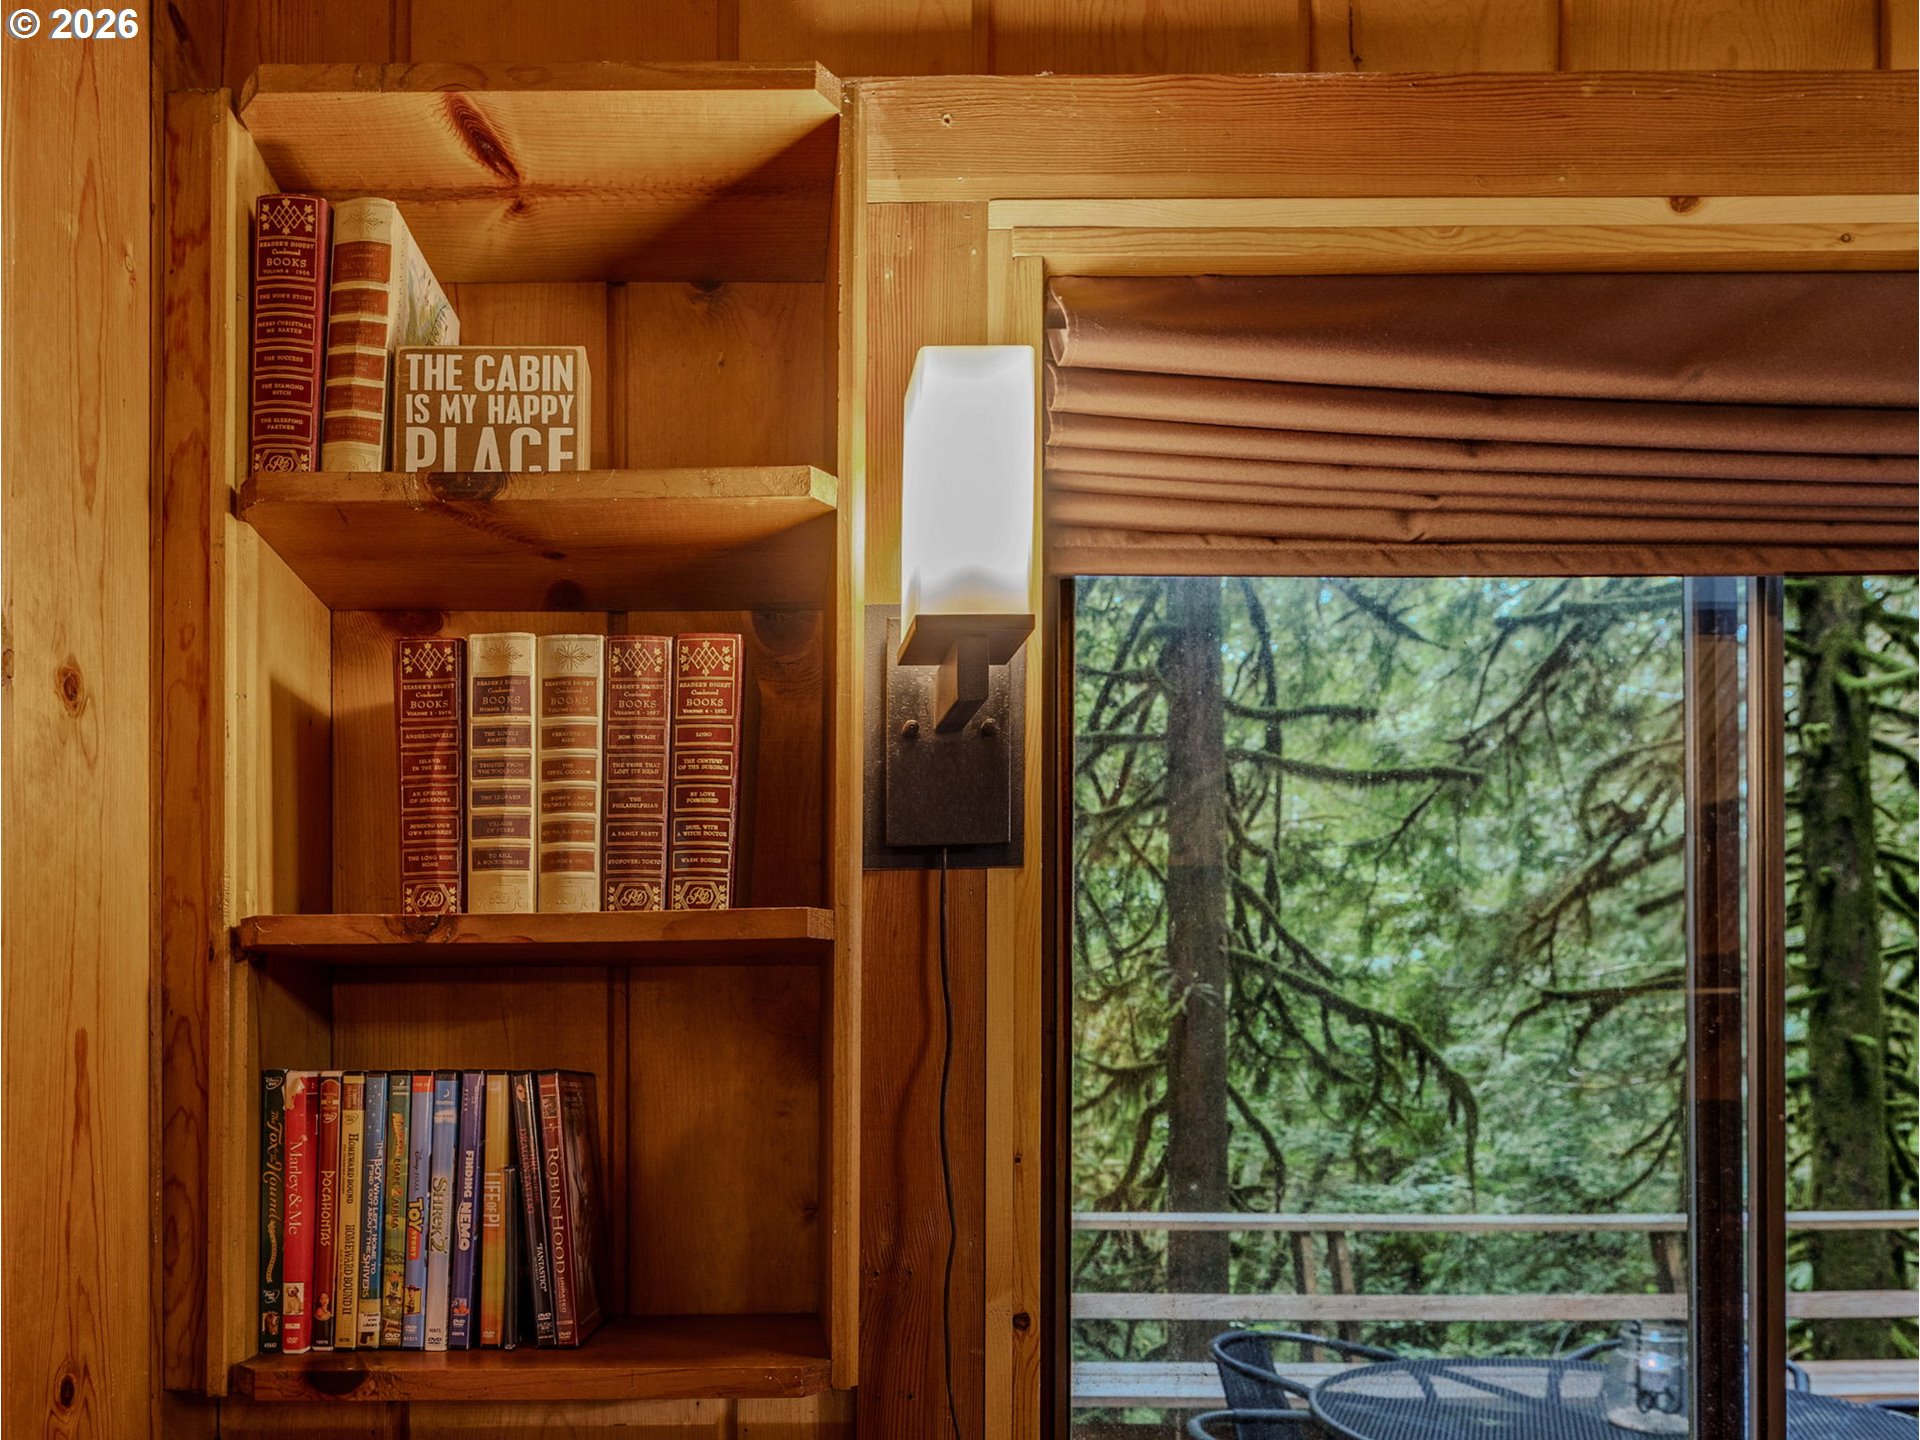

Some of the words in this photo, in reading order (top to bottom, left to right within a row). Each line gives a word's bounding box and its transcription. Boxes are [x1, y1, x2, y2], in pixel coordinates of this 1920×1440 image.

[259, 241, 289, 249] READER'S
[290, 241, 315, 250] DIGEST
[266, 257, 307, 268] BOOKS
[292, 293, 313, 302] STORY
[277, 327, 303, 335] BAXTER
[277, 355, 304, 363] SUCCESS
[405, 354, 463, 391] THE
[475, 354, 574, 392] CABIN
[274, 383, 305, 391] DIAMOND
[273, 417, 303, 425] SLEEPING
[406, 394, 430, 423] IS
[440, 394, 477, 424] MY
[488, 394, 575, 425] HAPPY
[405, 426, 575, 472] PLACE
[410, 700, 449, 709] BOOKS
[482, 695, 521, 705] BOOKS
[550, 696, 589, 705] BOOKS
[618, 699, 657, 708] BOOKS
[686, 698, 724, 707] BOOKS
[269, 1110, 280, 1124] The
[266, 1121, 283, 1152] Fox
[374, 1140, 384, 1158] THE
[346, 1132, 359, 1178] HOMEWARD
[518, 1128, 530, 1173] DRAGON
[287, 1141, 304, 1192] Marley
[366, 1164, 374, 1185] FIND
[370, 1158, 383, 1182] BOY
[393, 1158, 402, 1185] ESCAPE
[463, 1150, 474, 1198] FINDING
[547, 1144, 561, 1209] ROBIN
[262, 1161, 283, 1221] Hound
[346, 1178, 356, 1204] BOUND
[391, 1187, 403, 1197] 2
[484, 1172, 501, 1202] LIFE
[522, 1173, 534, 1214] TATTOO
[288, 1193, 303, 1208] &
[391, 1197, 400, 1229] AFRICA
[485, 1202, 497, 1213] OF
[287, 1210, 303, 1236] Me
[365, 1205, 373, 1234] ABOUT
[371, 1207, 379, 1231] LEFT
[408, 1197, 425, 1233] TOY
[458, 1201, 472, 1251] NEMO
[483, 1213, 500, 1228] PI
[343, 1224, 355, 1276] HOMEWARD
[410, 1230, 418, 1258] STORY
[430, 1237, 448, 1254] 2
[552, 1215, 565, 1274] HOOD
[360, 1253, 370, 1298] SHIVERS
[370, 1262, 376, 1275] TO
[342, 1276, 353, 1306] BOUND
[559, 1276, 567, 1313] UNRATED
[342, 1307, 352, 1315] II
